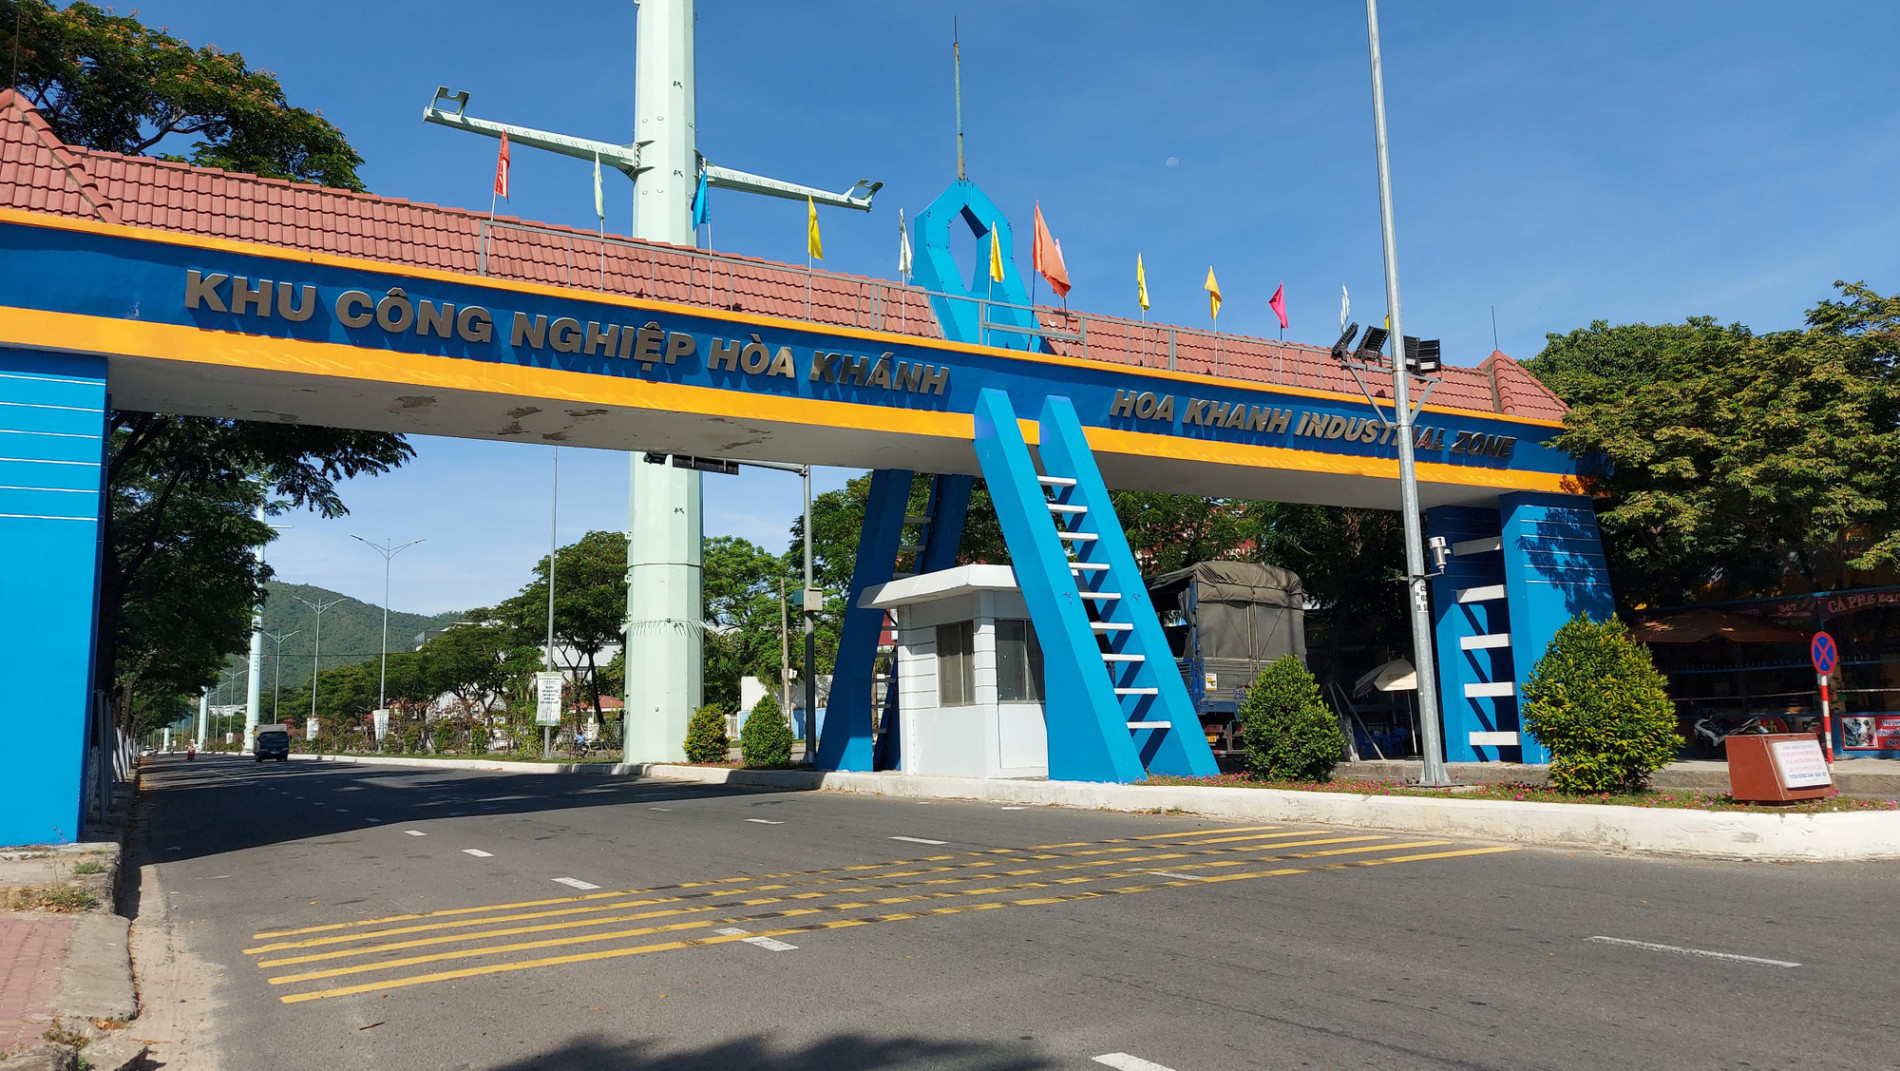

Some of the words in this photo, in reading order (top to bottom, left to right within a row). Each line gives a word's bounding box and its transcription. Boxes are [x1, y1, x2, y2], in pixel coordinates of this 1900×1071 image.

[185, 269, 316, 322] KHU
[335, 287, 493, 343] CÔNG
[510, 312, 696, 371] NGHIỆP
[707, 334, 795, 379] HÒA
[809, 351, 949, 396] KHÁNH
[1109, 389, 1174, 422] HOA
[1183, 398, 1292, 434] KHANH
[1449, 430, 1518, 459] ZONE
